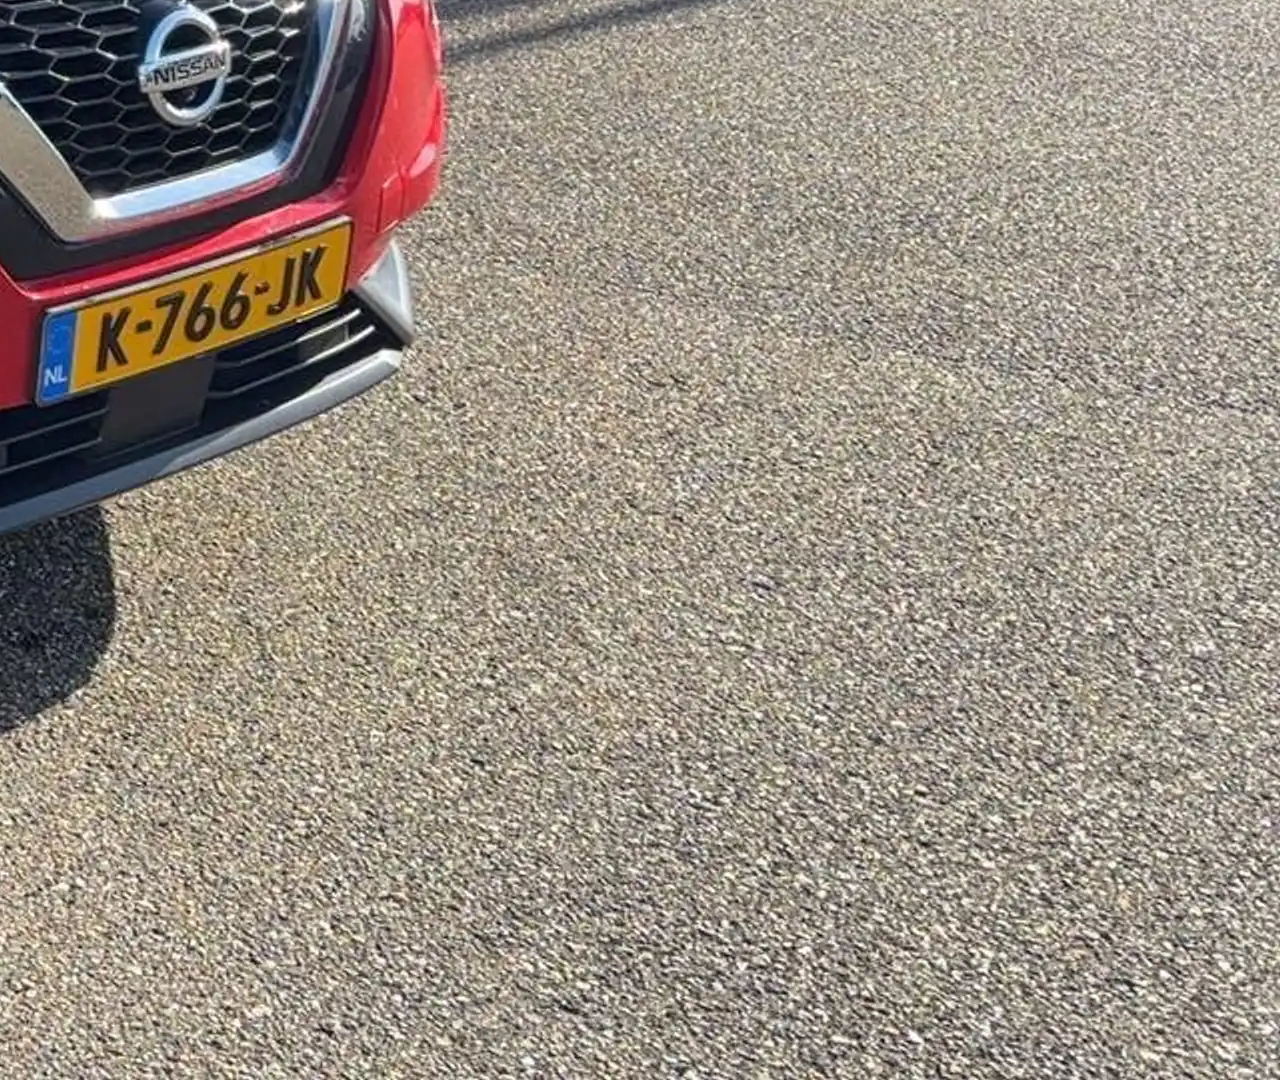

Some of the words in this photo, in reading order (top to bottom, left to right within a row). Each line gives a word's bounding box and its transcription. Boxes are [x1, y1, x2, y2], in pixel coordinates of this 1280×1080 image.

[152, 53, 225, 86] NISSAN
[95, 243, 329, 373] K-766-JK
[43, 365, 68, 389] NL
